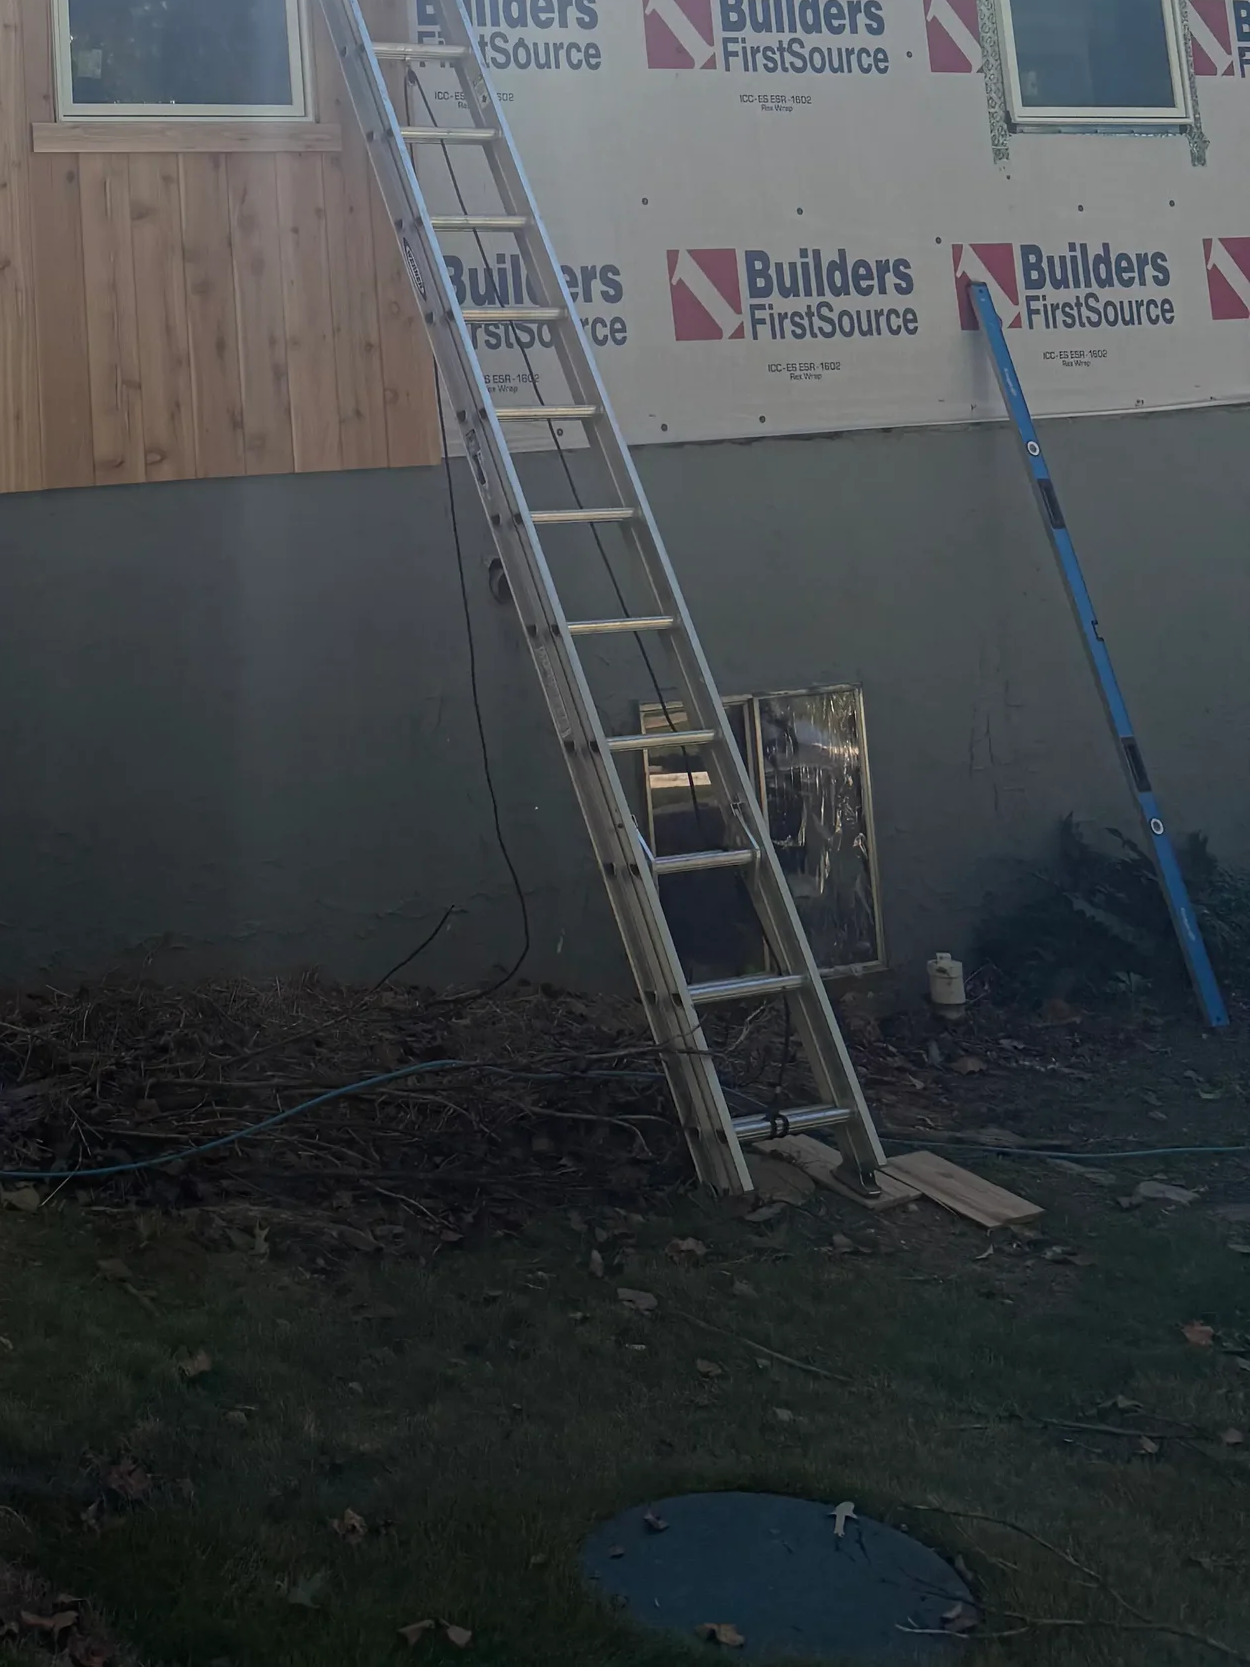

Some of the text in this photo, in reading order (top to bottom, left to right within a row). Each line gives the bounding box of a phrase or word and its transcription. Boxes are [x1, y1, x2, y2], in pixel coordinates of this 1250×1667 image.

[722, 37, 890, 75] FirstSource
[744, 247, 915, 299] Builders
[1019, 241, 1171, 291] Builders
[749, 301, 919, 341] FirstSource
[1024, 292, 1175, 330] FirstSource
[767, 363, 798, 373] ICC-ES
